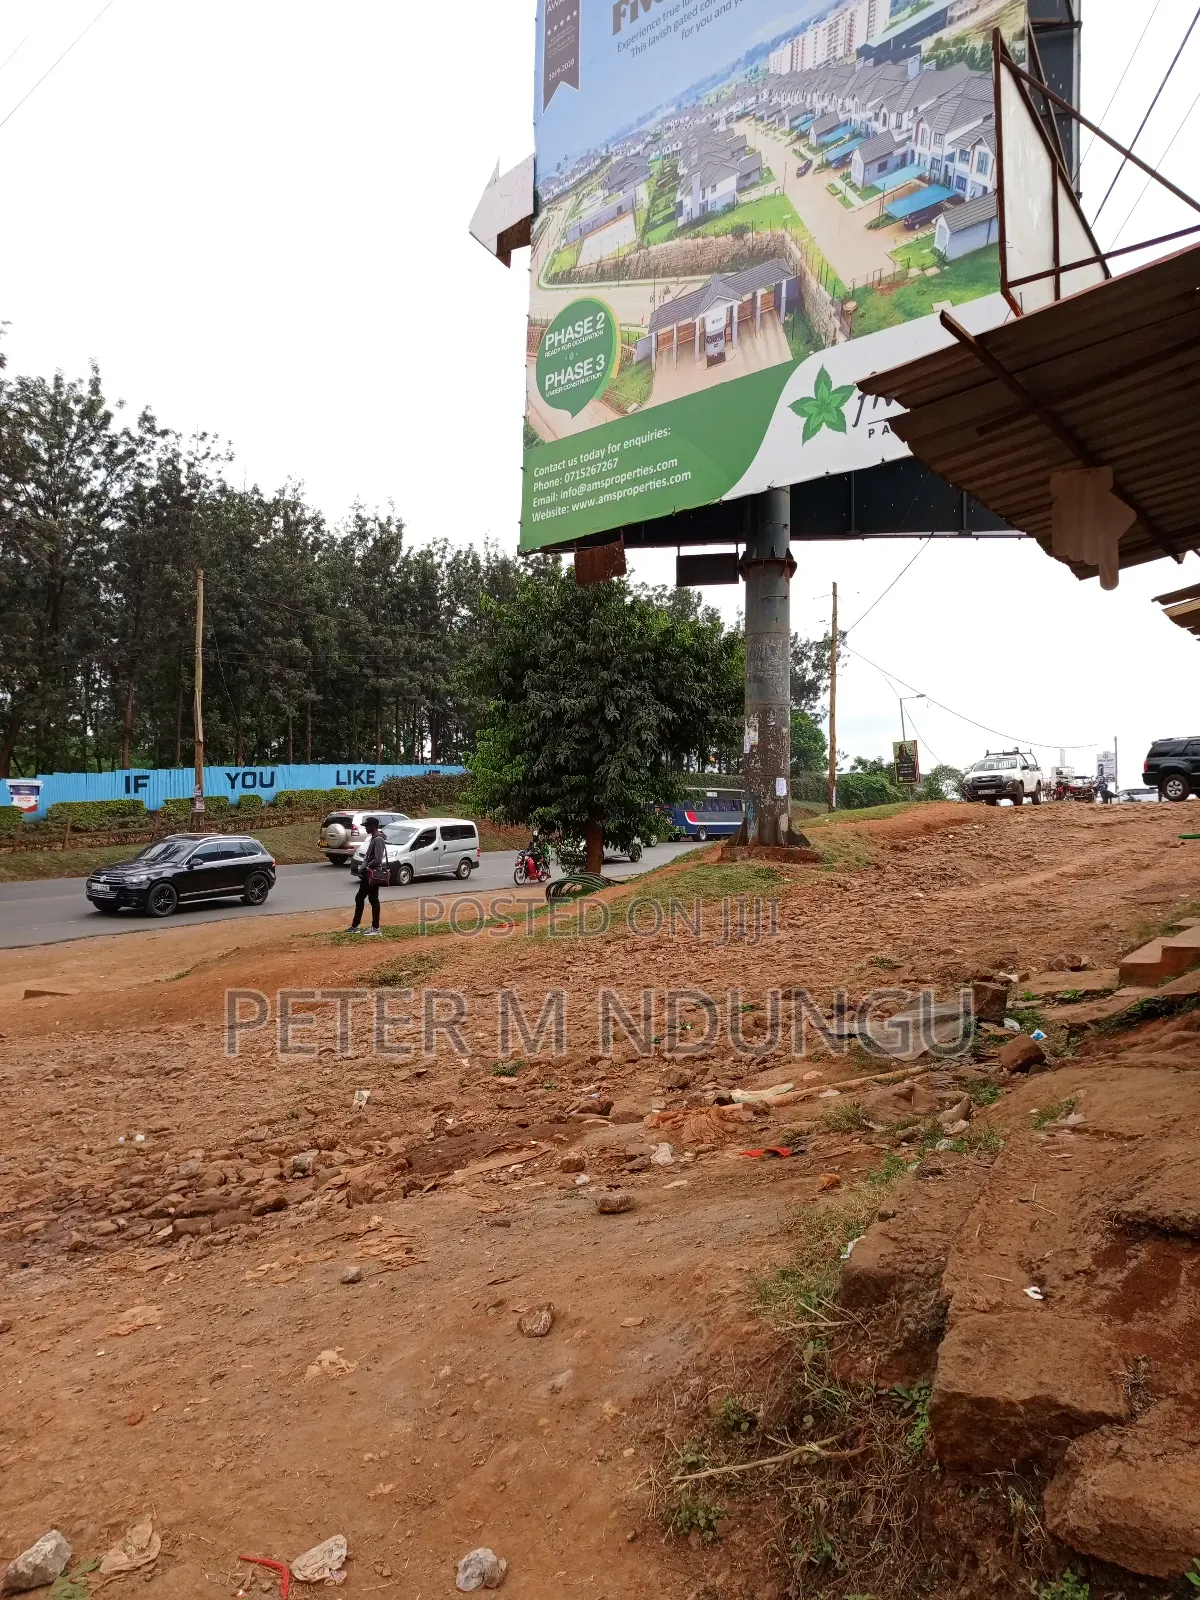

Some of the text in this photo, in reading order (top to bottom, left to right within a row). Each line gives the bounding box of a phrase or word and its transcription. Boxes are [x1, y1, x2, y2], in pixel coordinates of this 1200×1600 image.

[612, 0, 664, 36] Fiv
[617, 17, 661, 53] Experience
[662, 4, 680, 21] true
[630, 42, 647, 58] This
[648, 24, 672, 47] lavish
[673, 4, 698, 32] gated
[681, 25, 694, 41] for
[695, 13, 713, 33] you
[714, 0, 732, 19] and
[548, 58, 575, 81] 2019-2020
[544, 328, 604, 359] READY FOR OCCUPATION
[545, 311, 605, 351] PHASE 2
[545, 353, 605, 391] PHASE 3
[545, 372, 602, 398] UNDER CONSTRUCTION
[533, 426, 671, 478] Contact us today for enquiries:
[532, 457, 678, 508] Email: info@amsproperties.com
[533, 457, 619, 493] Phone: 0715267267
[531, 470, 692, 523] Website: www.amsproperties.com
[124, 769, 376, 794] IF YOU LIKE
